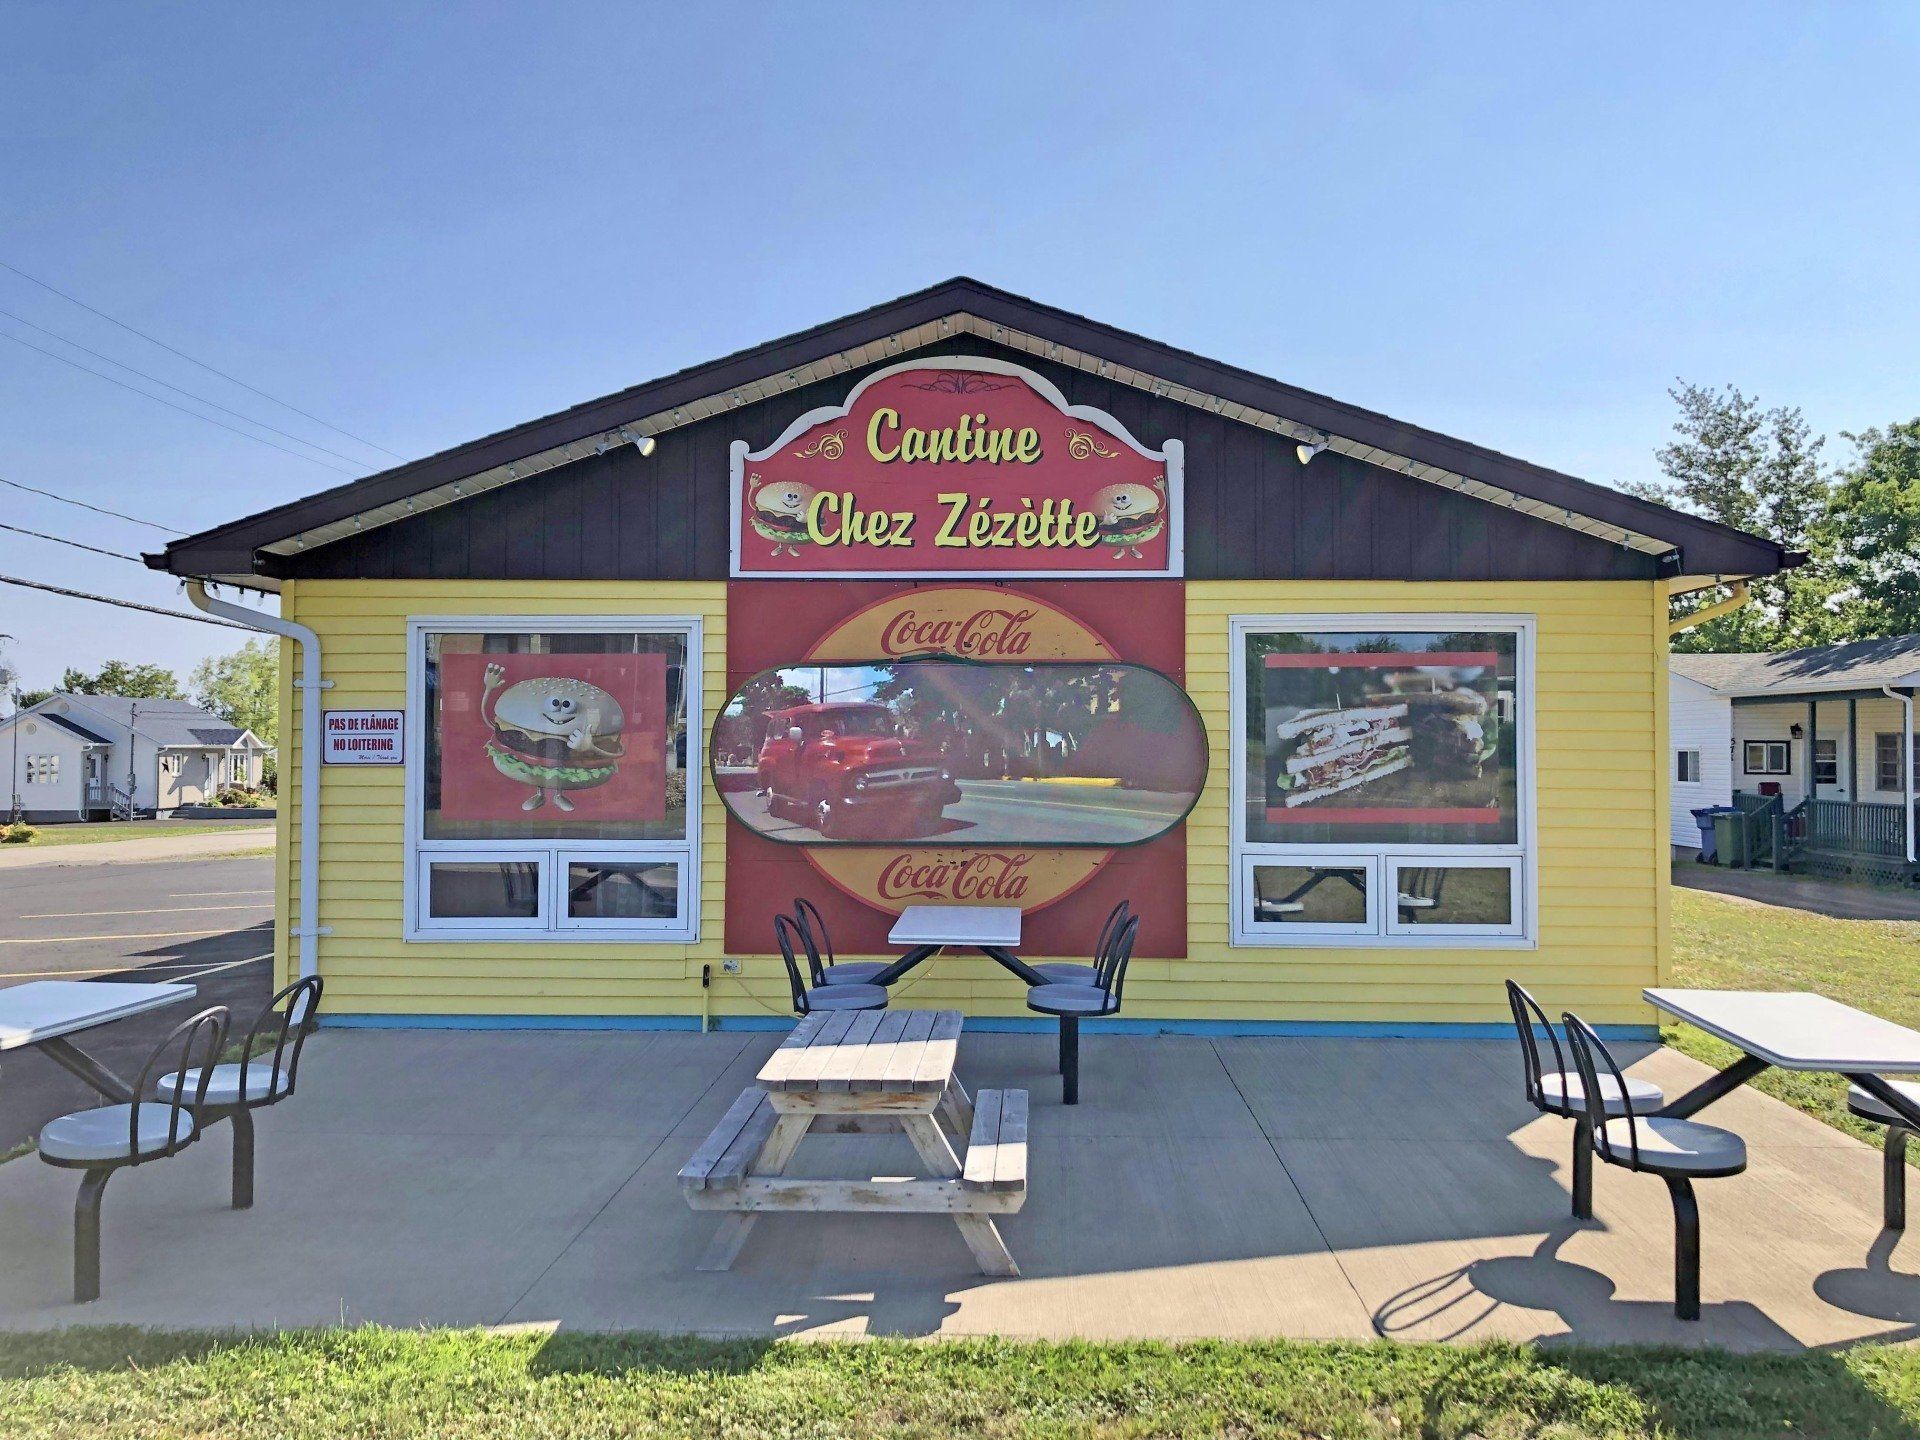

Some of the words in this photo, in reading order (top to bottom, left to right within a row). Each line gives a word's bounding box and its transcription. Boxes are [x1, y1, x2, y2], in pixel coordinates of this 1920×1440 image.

[866, 407, 1043, 464] Cantine
[807, 490, 917, 548] Chez
[934, 491, 1101, 547] Zézètte
[880, 609, 1038, 656] Coca-Cola
[328, 718, 346, 730] PAS
[347, 718, 359, 730] DE
[360, 713, 399, 730] FLÂNAGE
[333, 738, 346, 751] NO
[347, 738, 394, 751] LOITERING
[877, 853, 1037, 899] Coca-Cola
